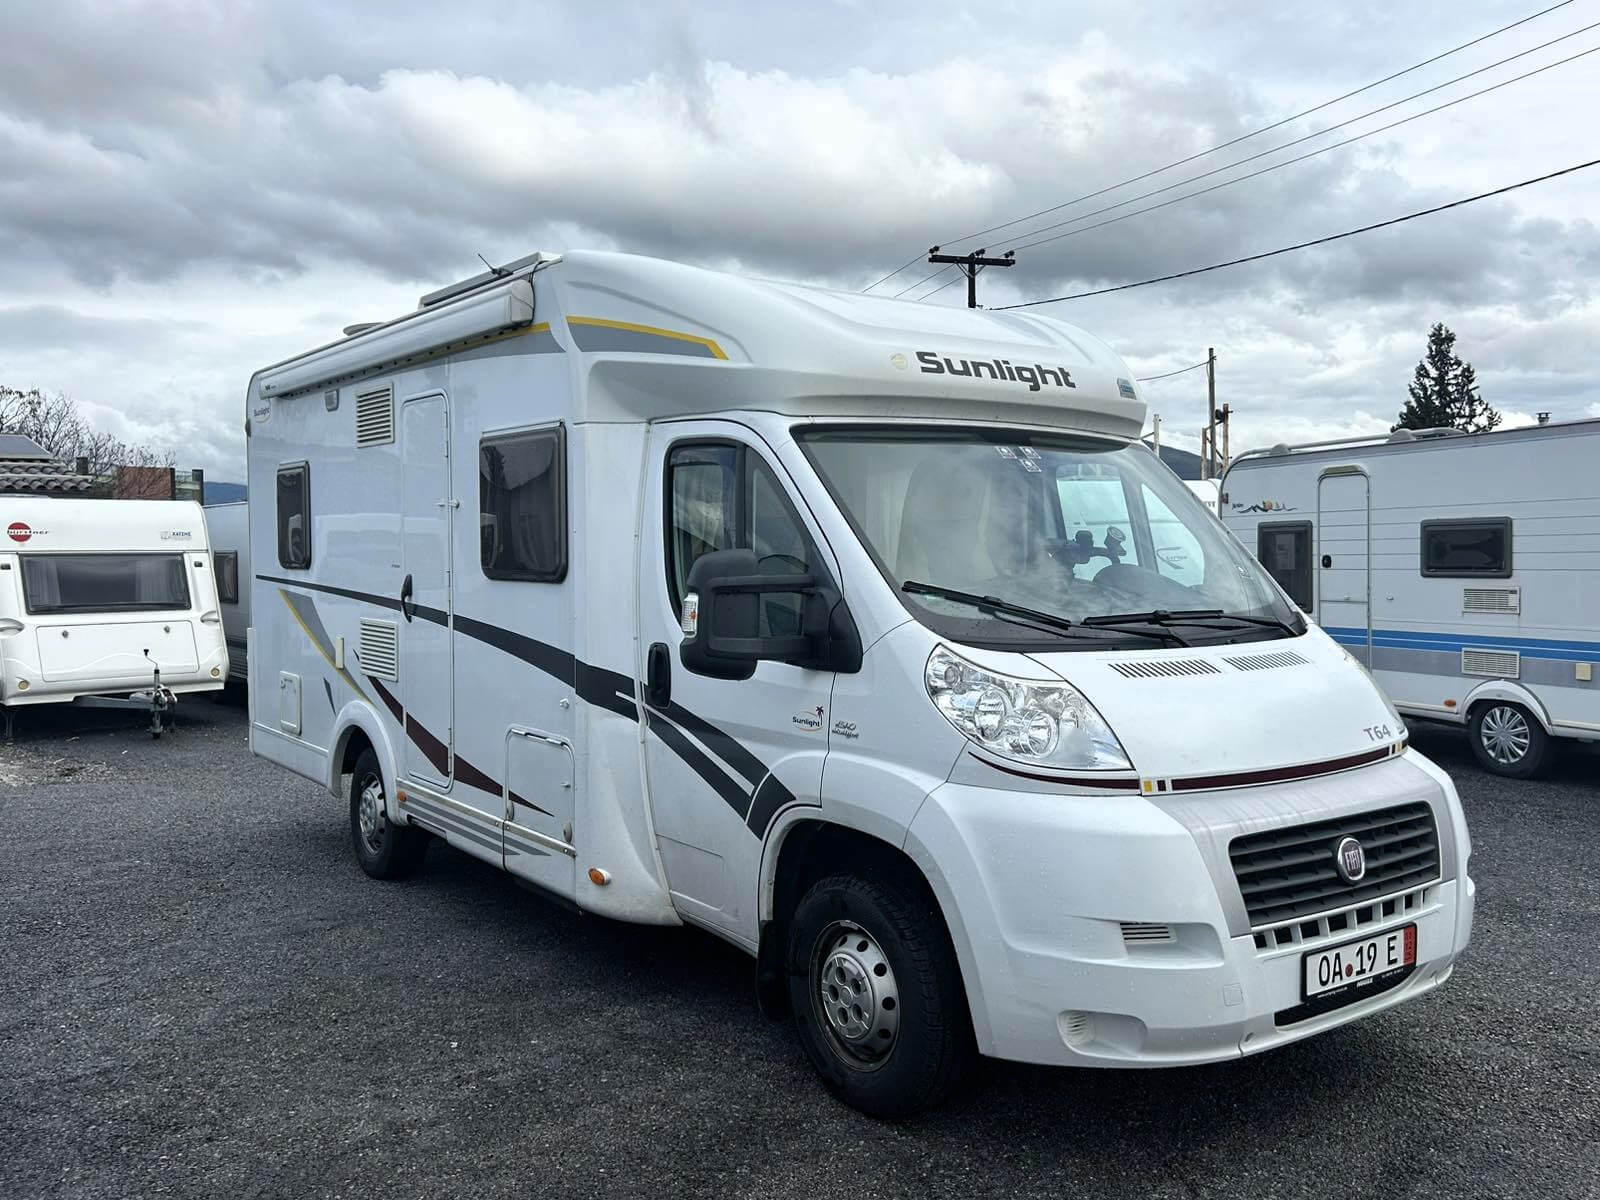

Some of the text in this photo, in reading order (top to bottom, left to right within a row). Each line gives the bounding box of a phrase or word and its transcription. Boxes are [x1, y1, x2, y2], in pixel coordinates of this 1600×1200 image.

[916, 351, 1077, 391] Sunlight
[792, 716, 820, 728] Sunlight
[1363, 724, 1391, 742] T64
[1344, 849, 1361, 871] FIAT
[1387, 935, 1399, 966] E
